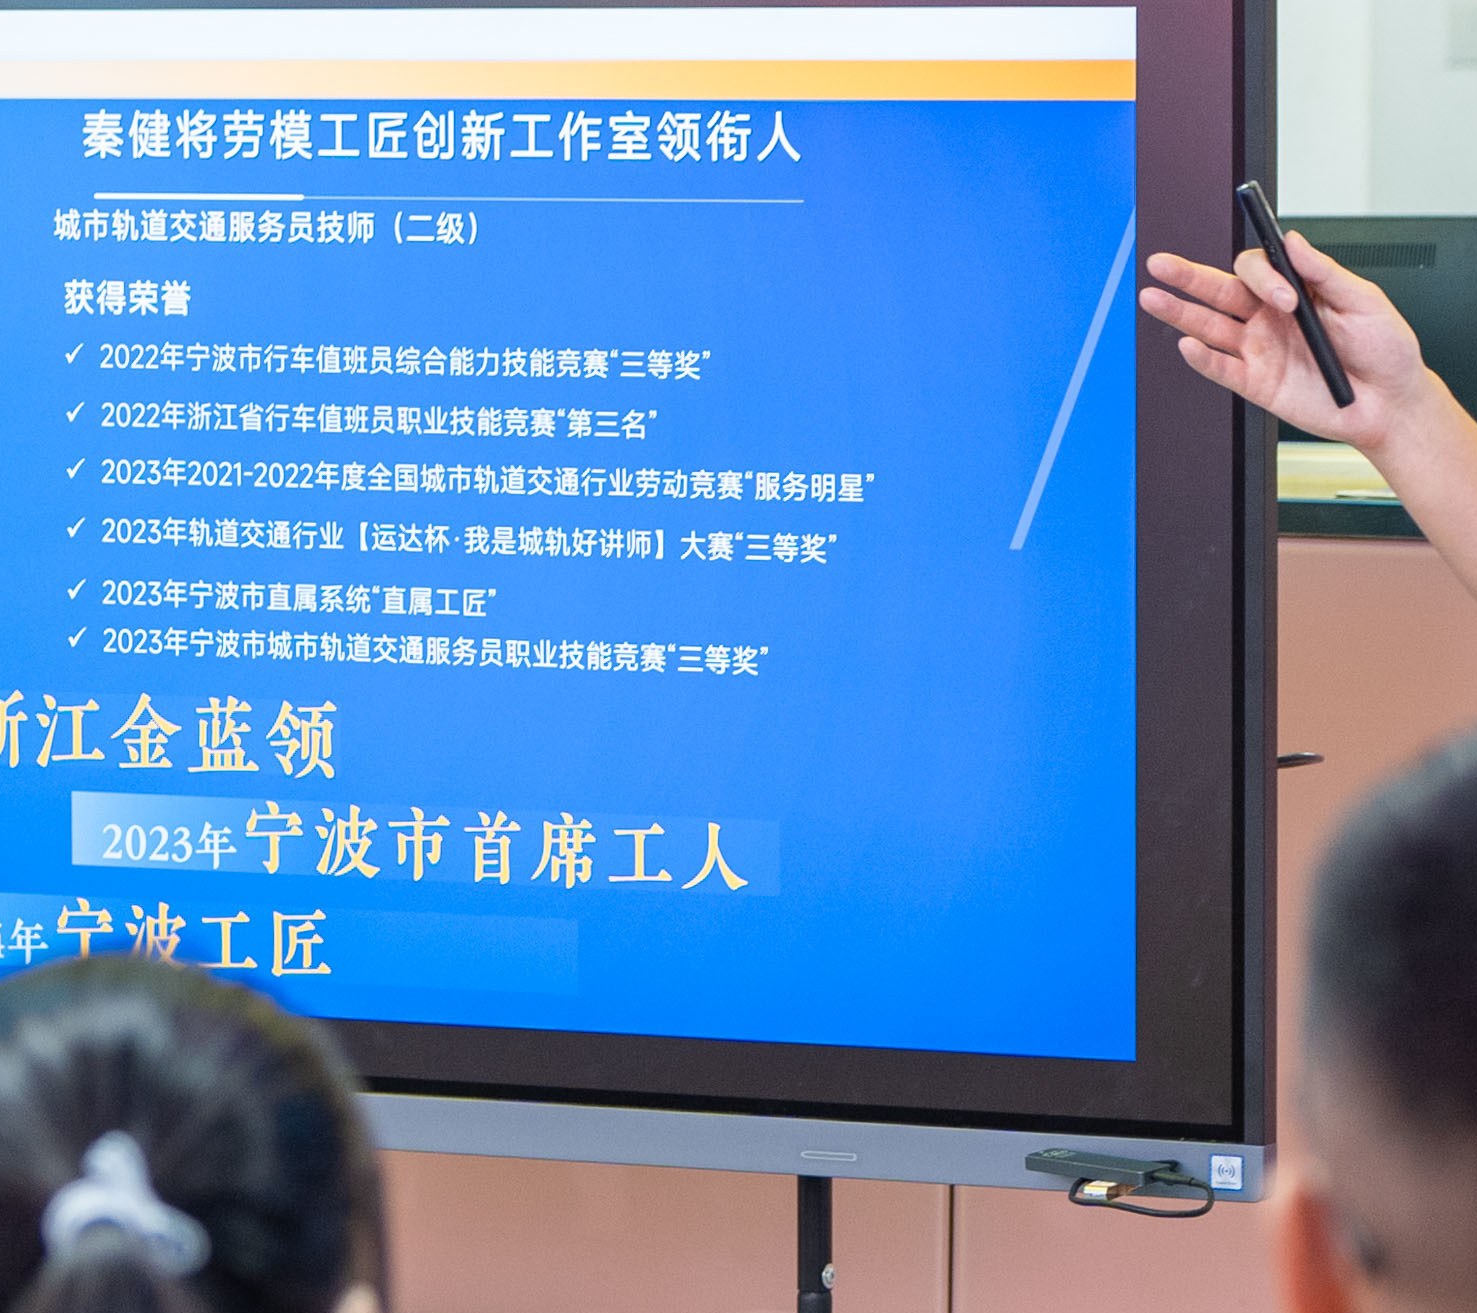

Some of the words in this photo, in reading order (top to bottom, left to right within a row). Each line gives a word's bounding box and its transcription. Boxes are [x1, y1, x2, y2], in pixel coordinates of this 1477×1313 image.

[82, 109, 801, 162] 秦健将劳模工匠创新工作室领衔人
[64, 279, 191, 316] 获得荣誉
[102, 801, 748, 890] 2023年宁波市首席工人
